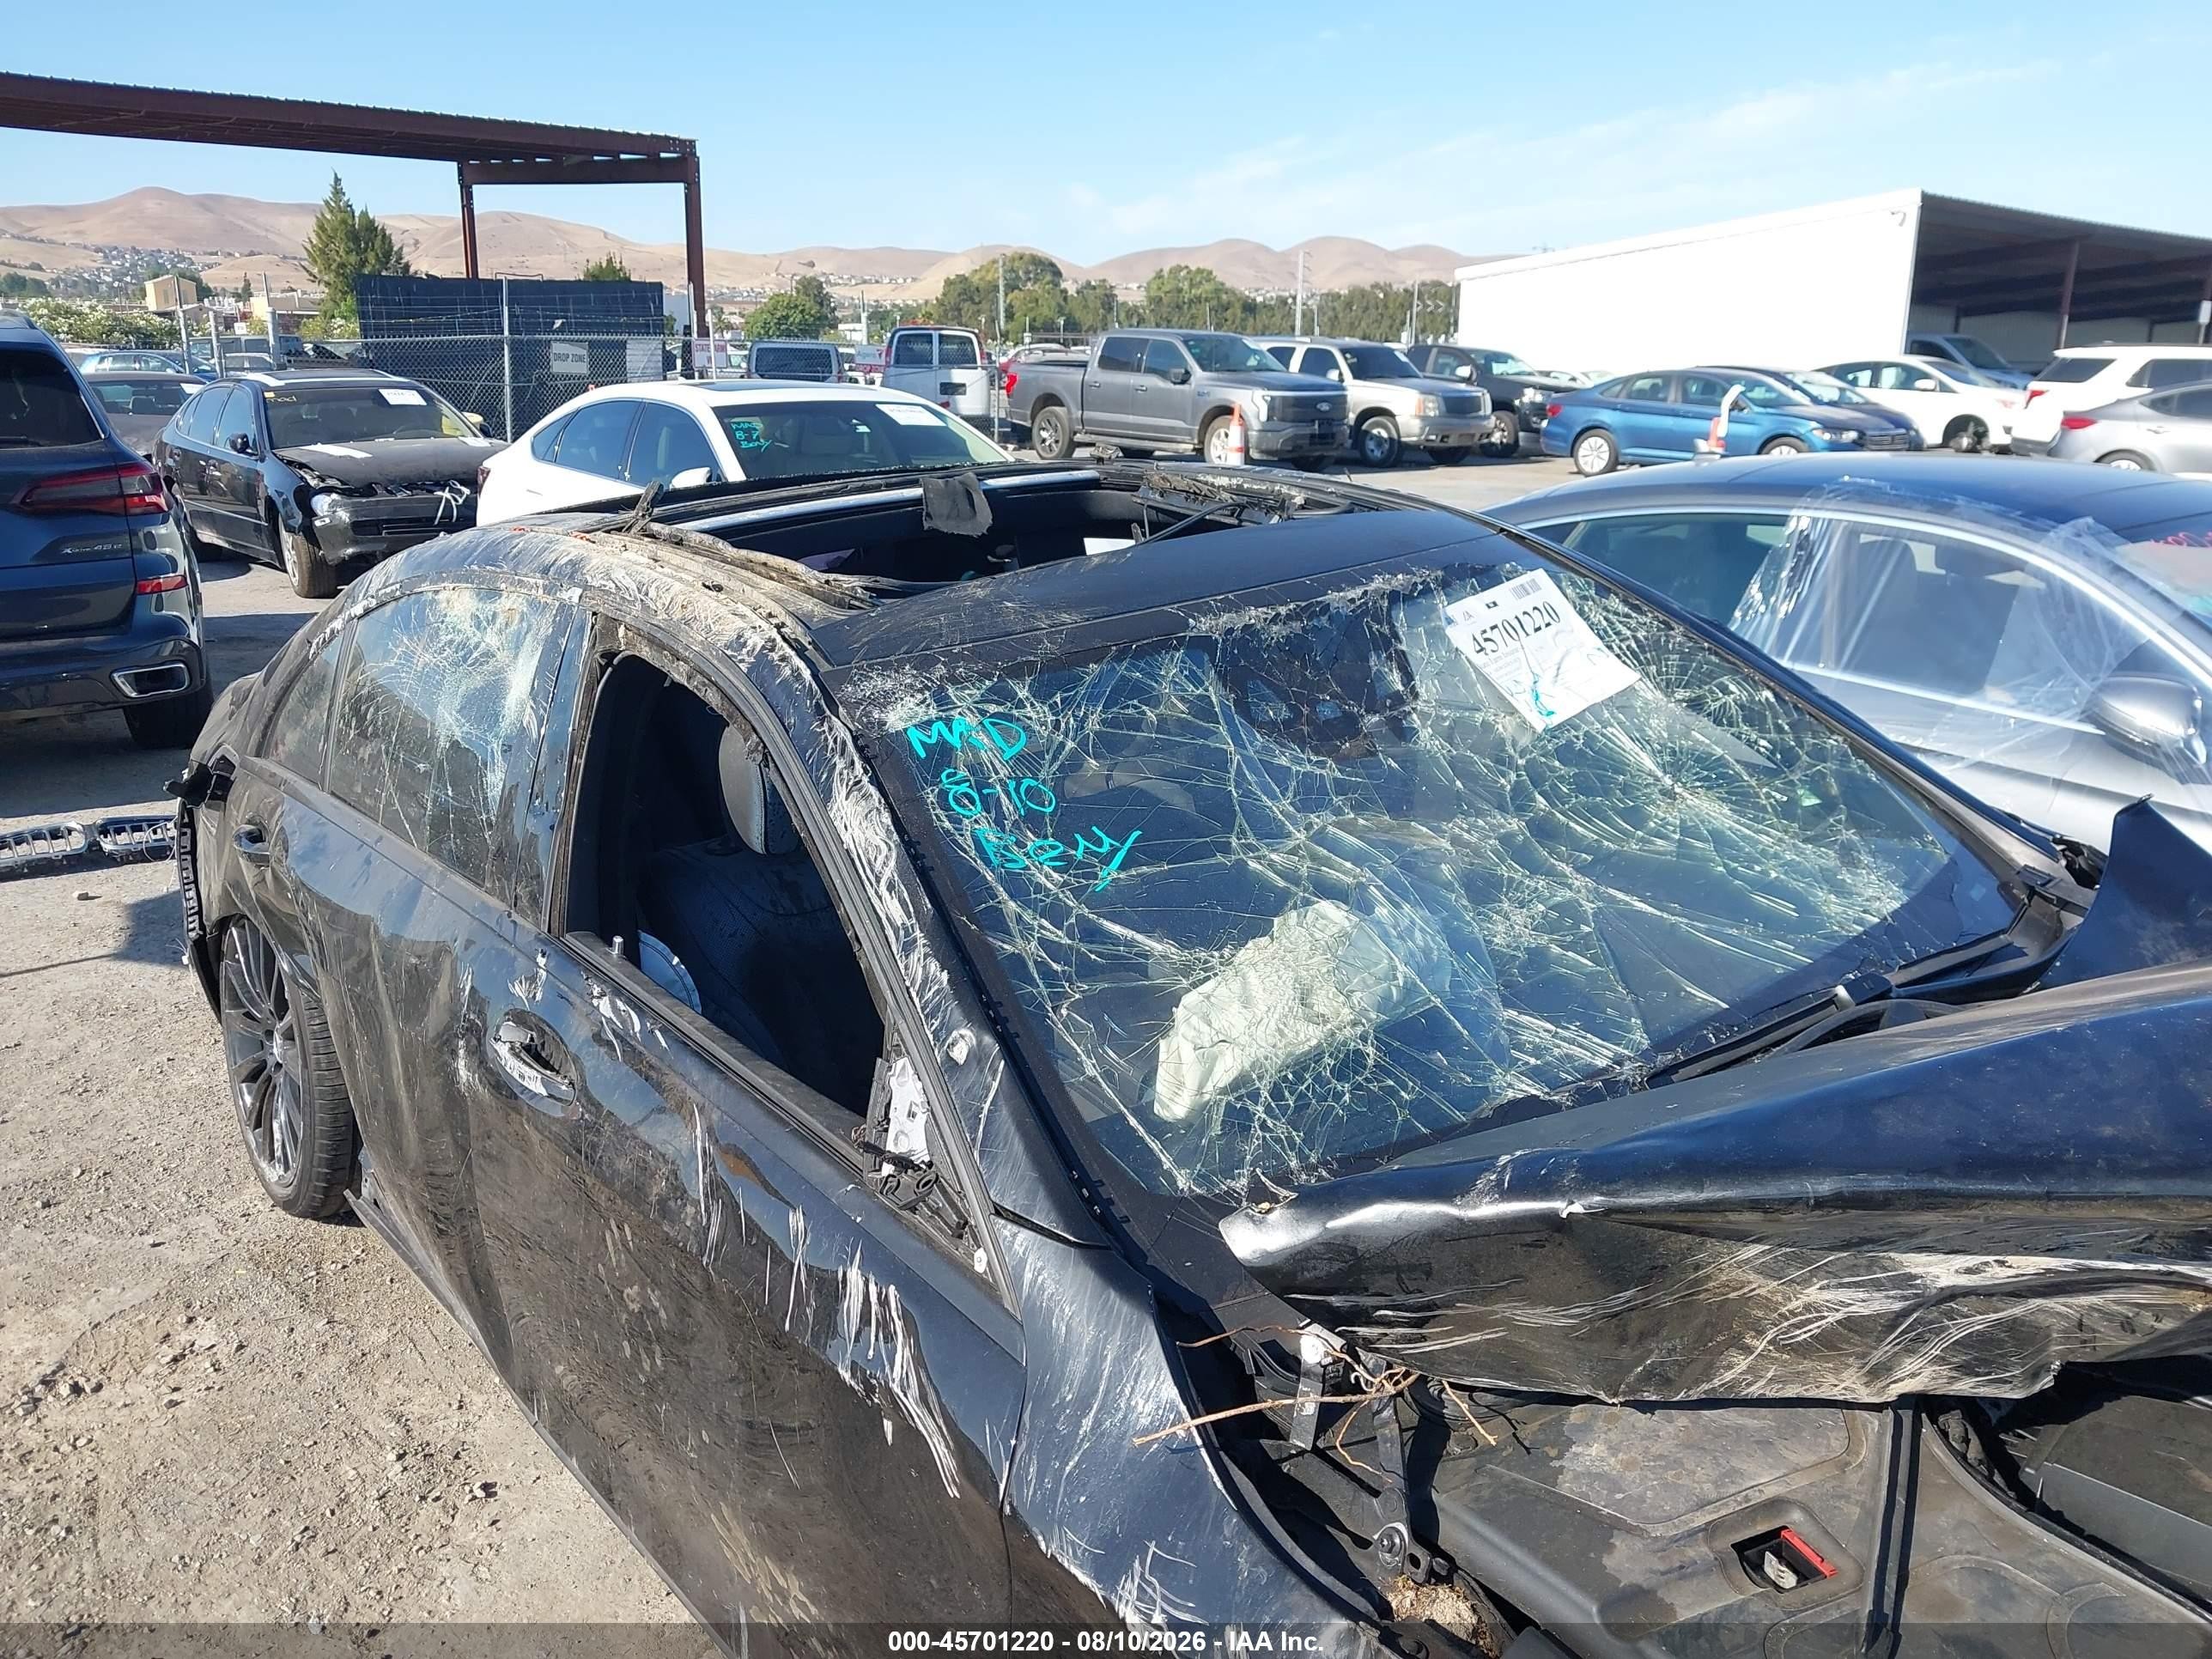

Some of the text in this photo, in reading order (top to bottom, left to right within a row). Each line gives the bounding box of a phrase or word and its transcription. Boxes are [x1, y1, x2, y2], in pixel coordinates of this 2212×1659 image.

[553, 352, 586, 363] DROP ZONE
[1472, 601, 1561, 656] 45701220
[907, 716, 1027, 761] MAD
[941, 768, 1056, 818] 8-10
